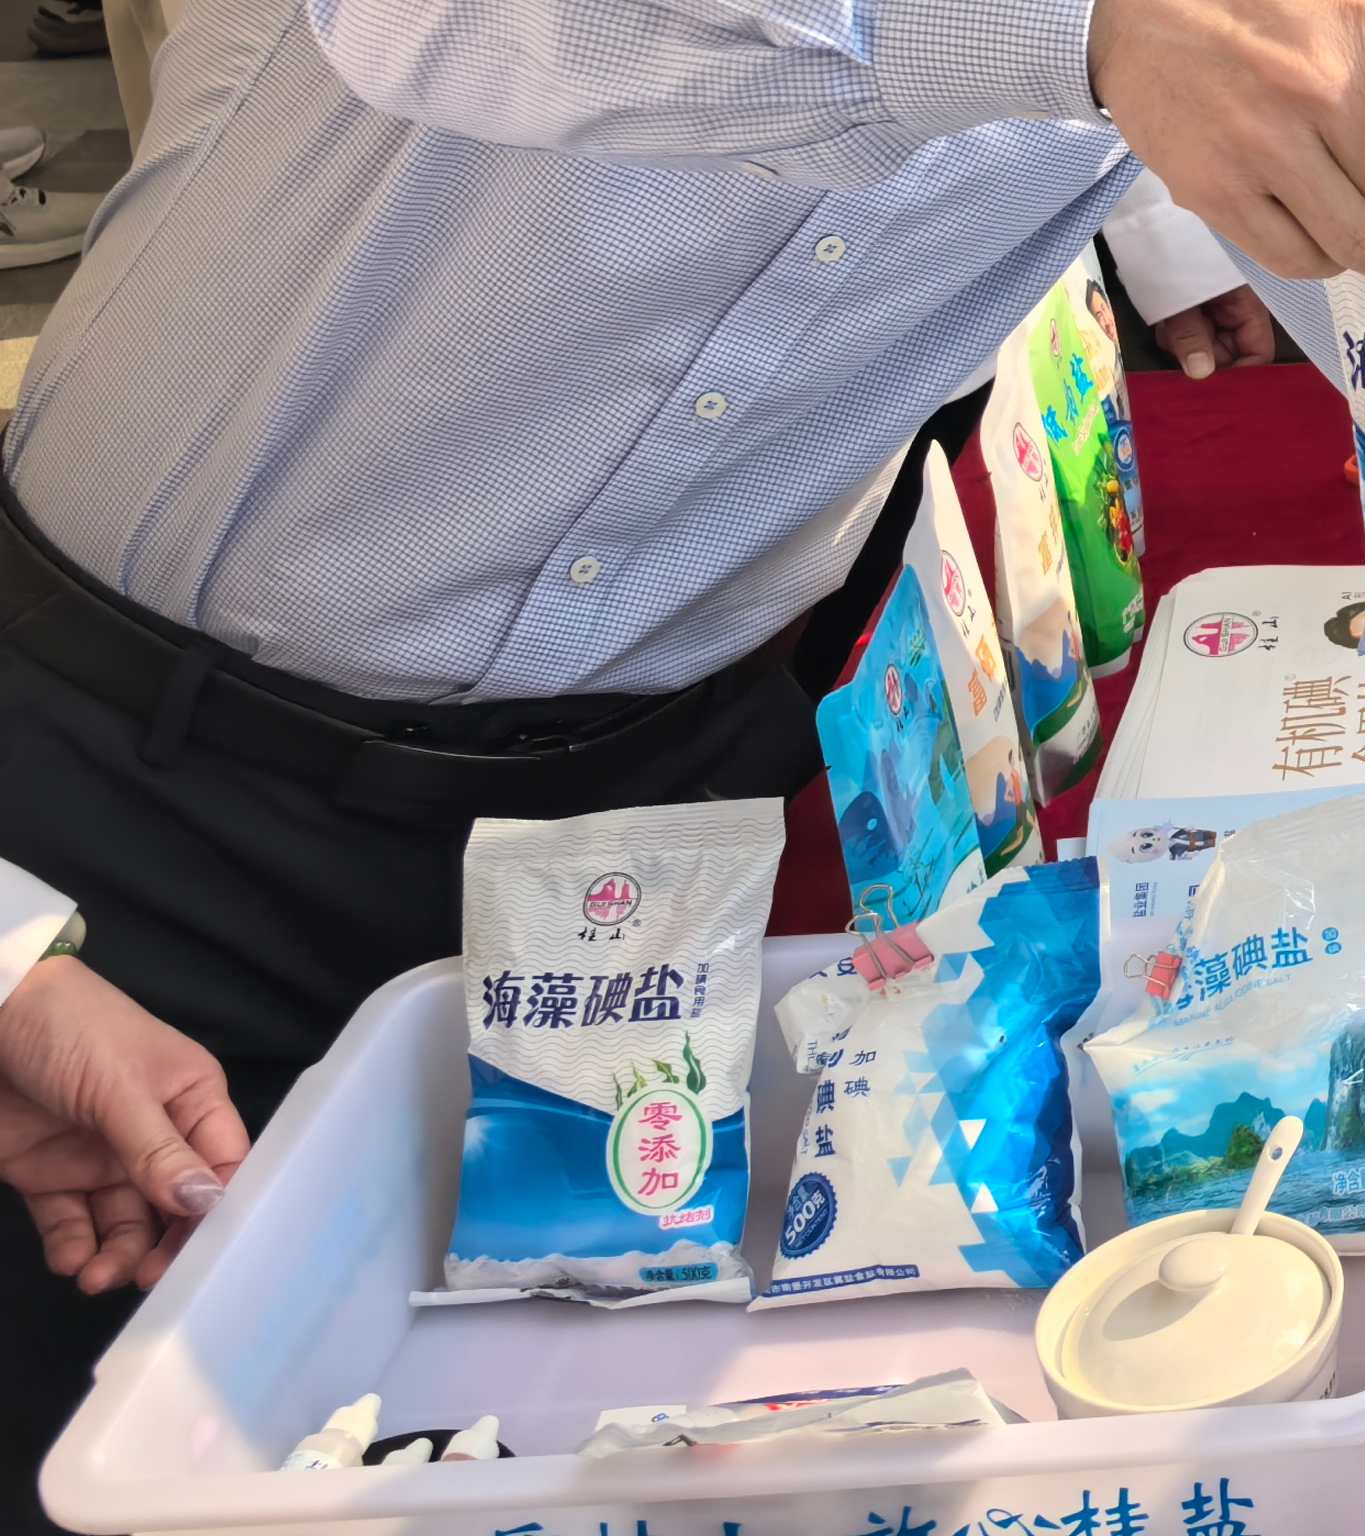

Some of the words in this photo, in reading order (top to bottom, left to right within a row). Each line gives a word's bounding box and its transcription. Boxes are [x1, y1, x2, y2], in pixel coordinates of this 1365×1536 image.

[1271, 675, 1353, 781] 有机碘
[482, 963, 685, 1030] 海藻碘盐
[844, 1049, 877, 1097] 加碘
[637, 1101, 683, 1196] 零添加
